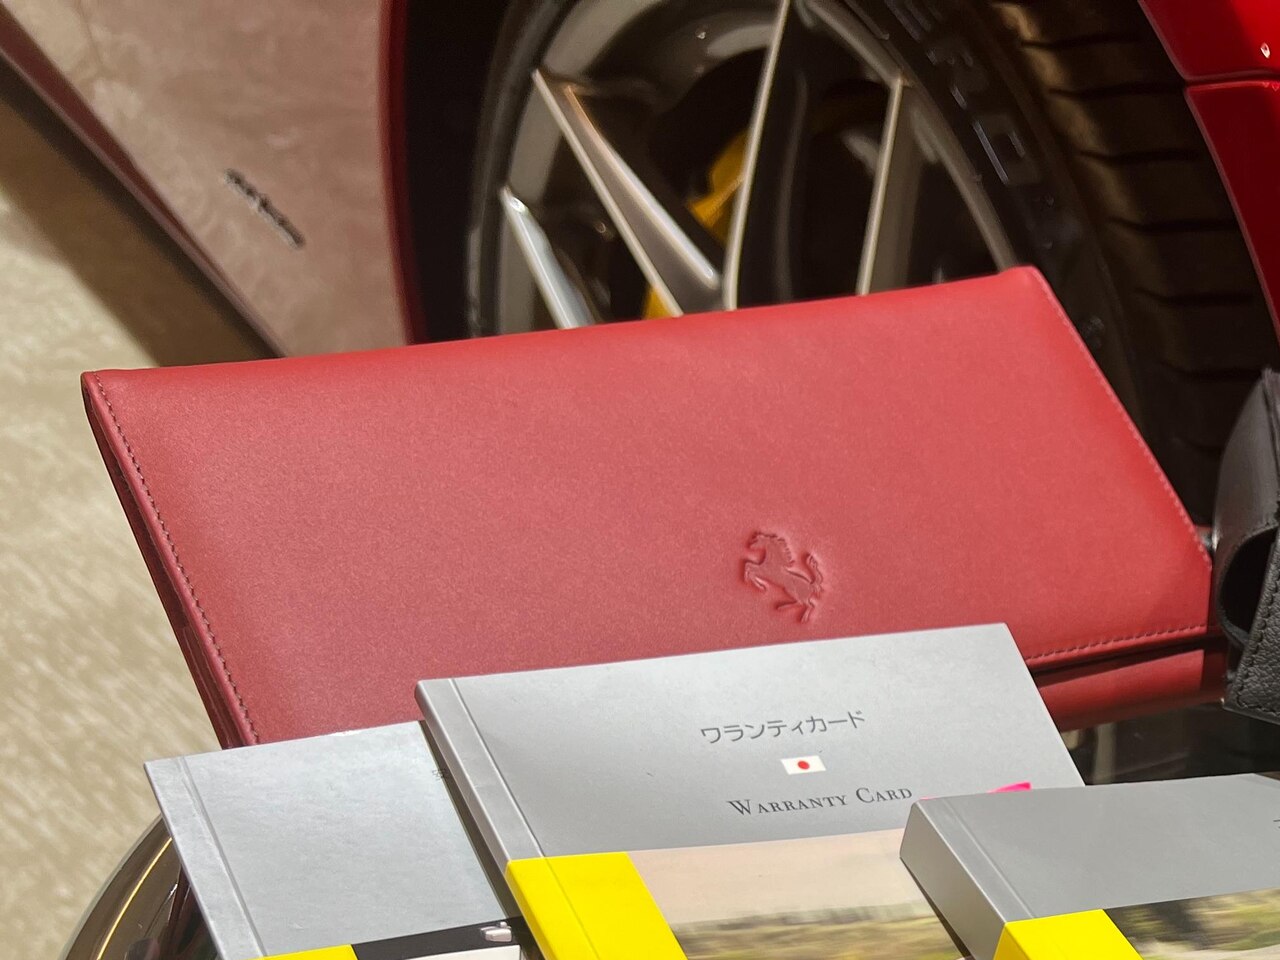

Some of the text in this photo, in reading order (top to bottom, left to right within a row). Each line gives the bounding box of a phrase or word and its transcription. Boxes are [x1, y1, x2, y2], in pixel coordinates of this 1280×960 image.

[700, 710, 866, 745] ワランティカード
[728, 786, 914, 816] WARRANTY CARD
